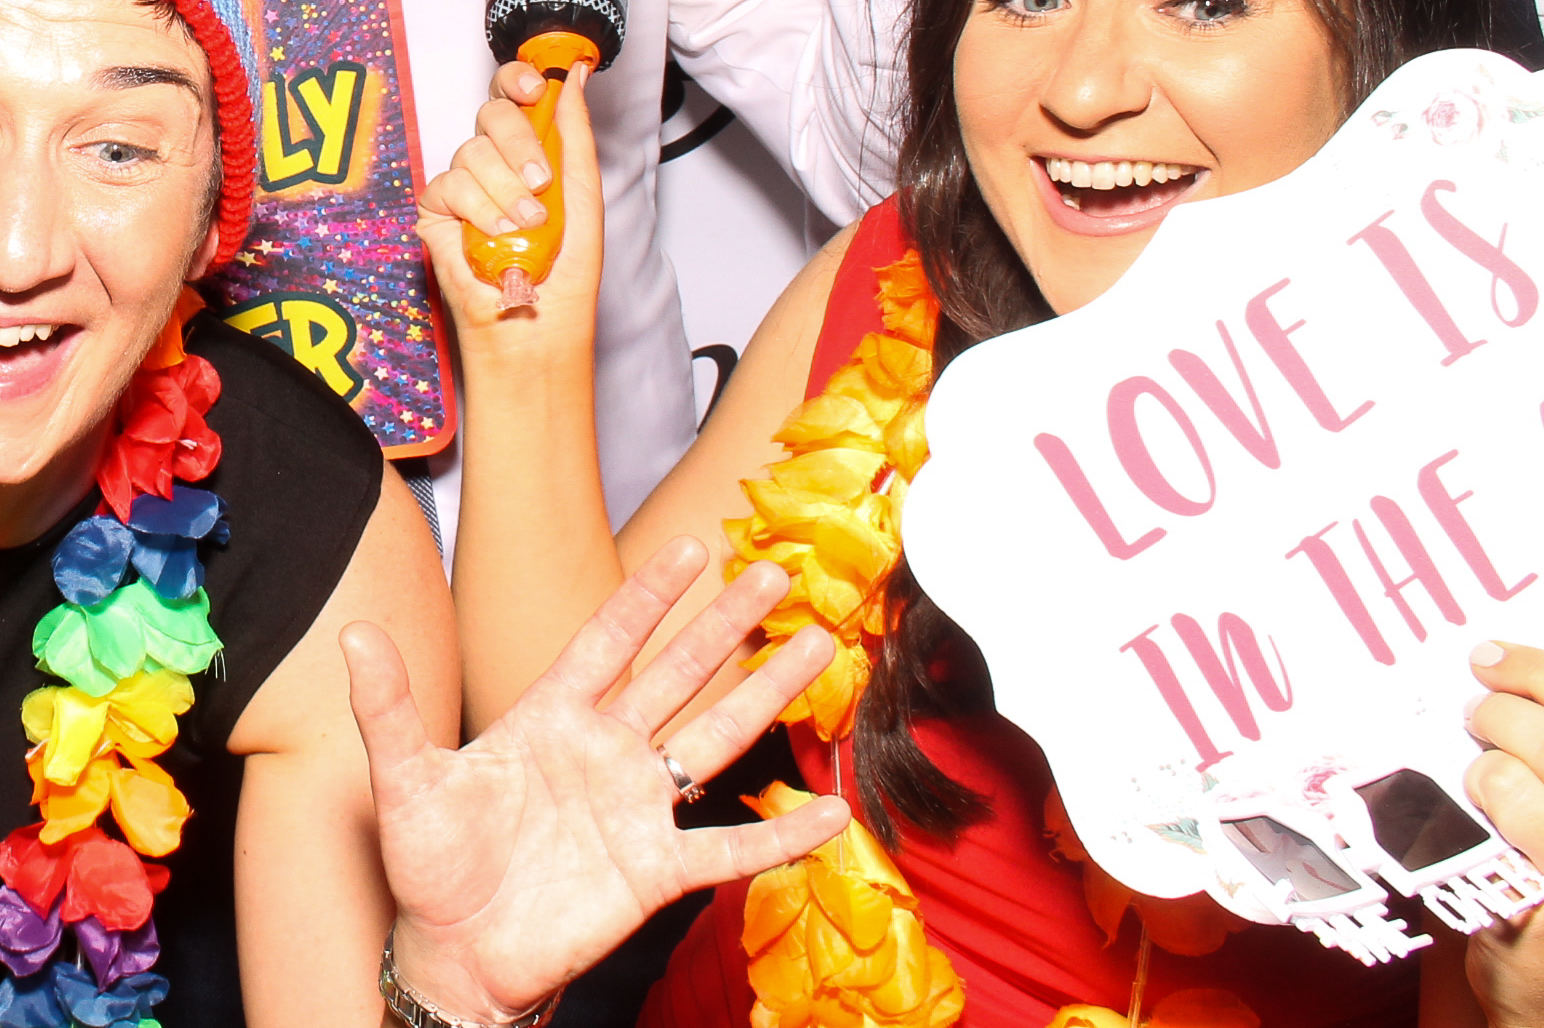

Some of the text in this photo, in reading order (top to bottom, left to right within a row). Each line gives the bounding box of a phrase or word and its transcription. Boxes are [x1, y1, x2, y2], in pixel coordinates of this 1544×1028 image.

[1032, 179, 1539, 561] LOVE IS
[1119, 449, 1539, 773] IN THE
